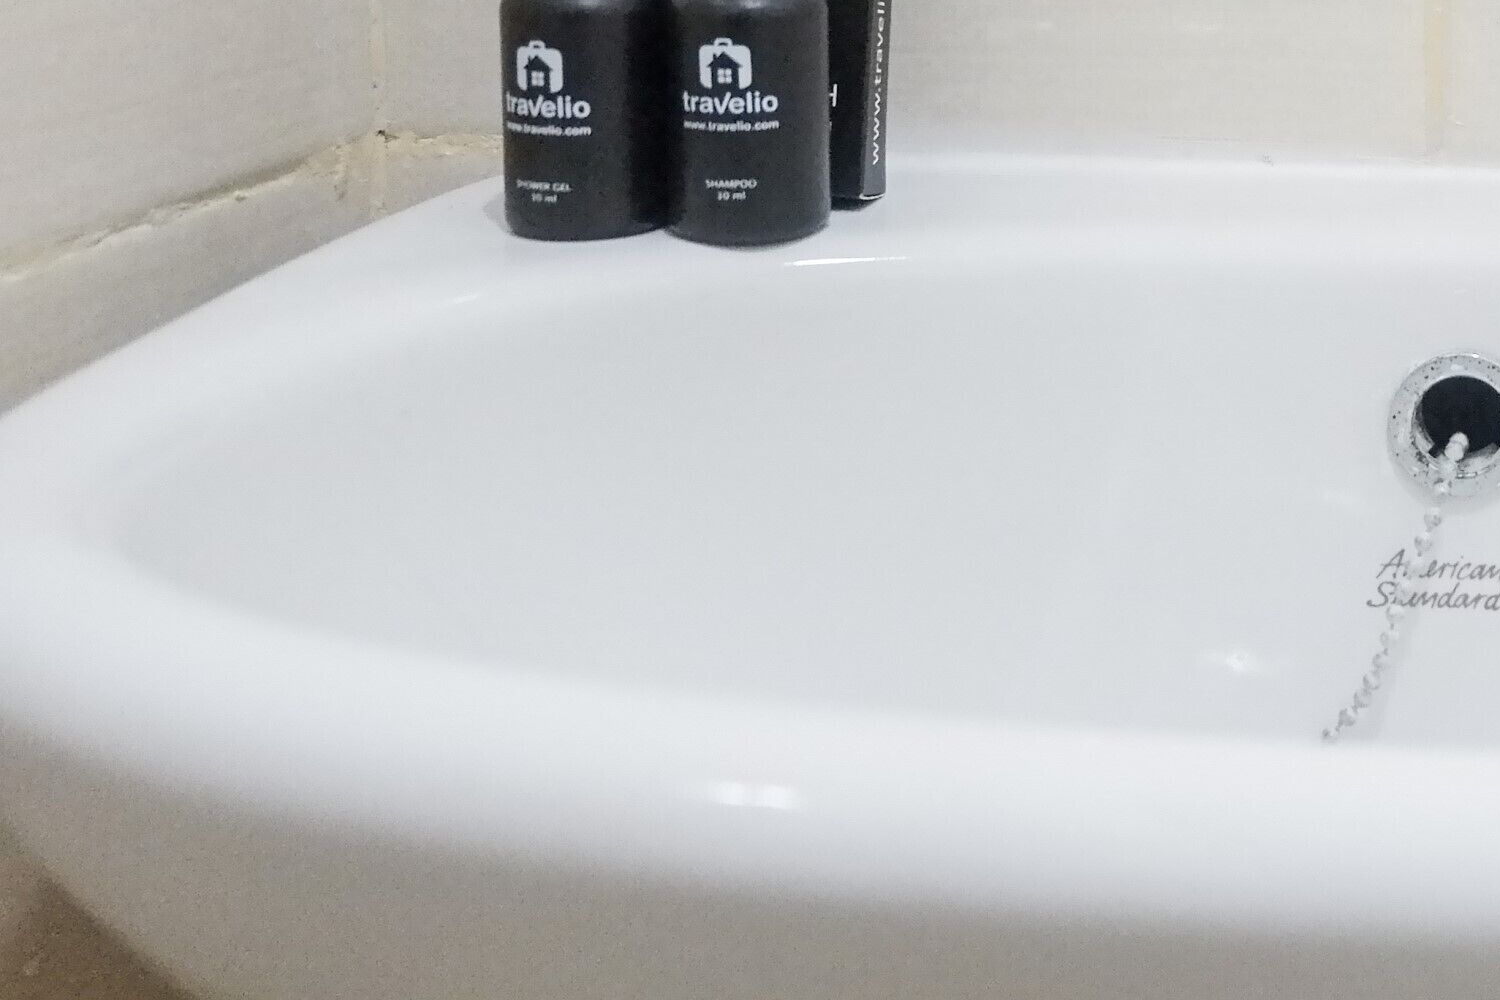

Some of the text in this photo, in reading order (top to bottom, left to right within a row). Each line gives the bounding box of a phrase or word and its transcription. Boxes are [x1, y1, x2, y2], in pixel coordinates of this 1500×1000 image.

[506, 90, 592, 119] travelio
[682, 89, 779, 115] travelio
[683, 120, 780, 132] www.travelio.com
[705, 179, 758, 190] SHAMPOO
